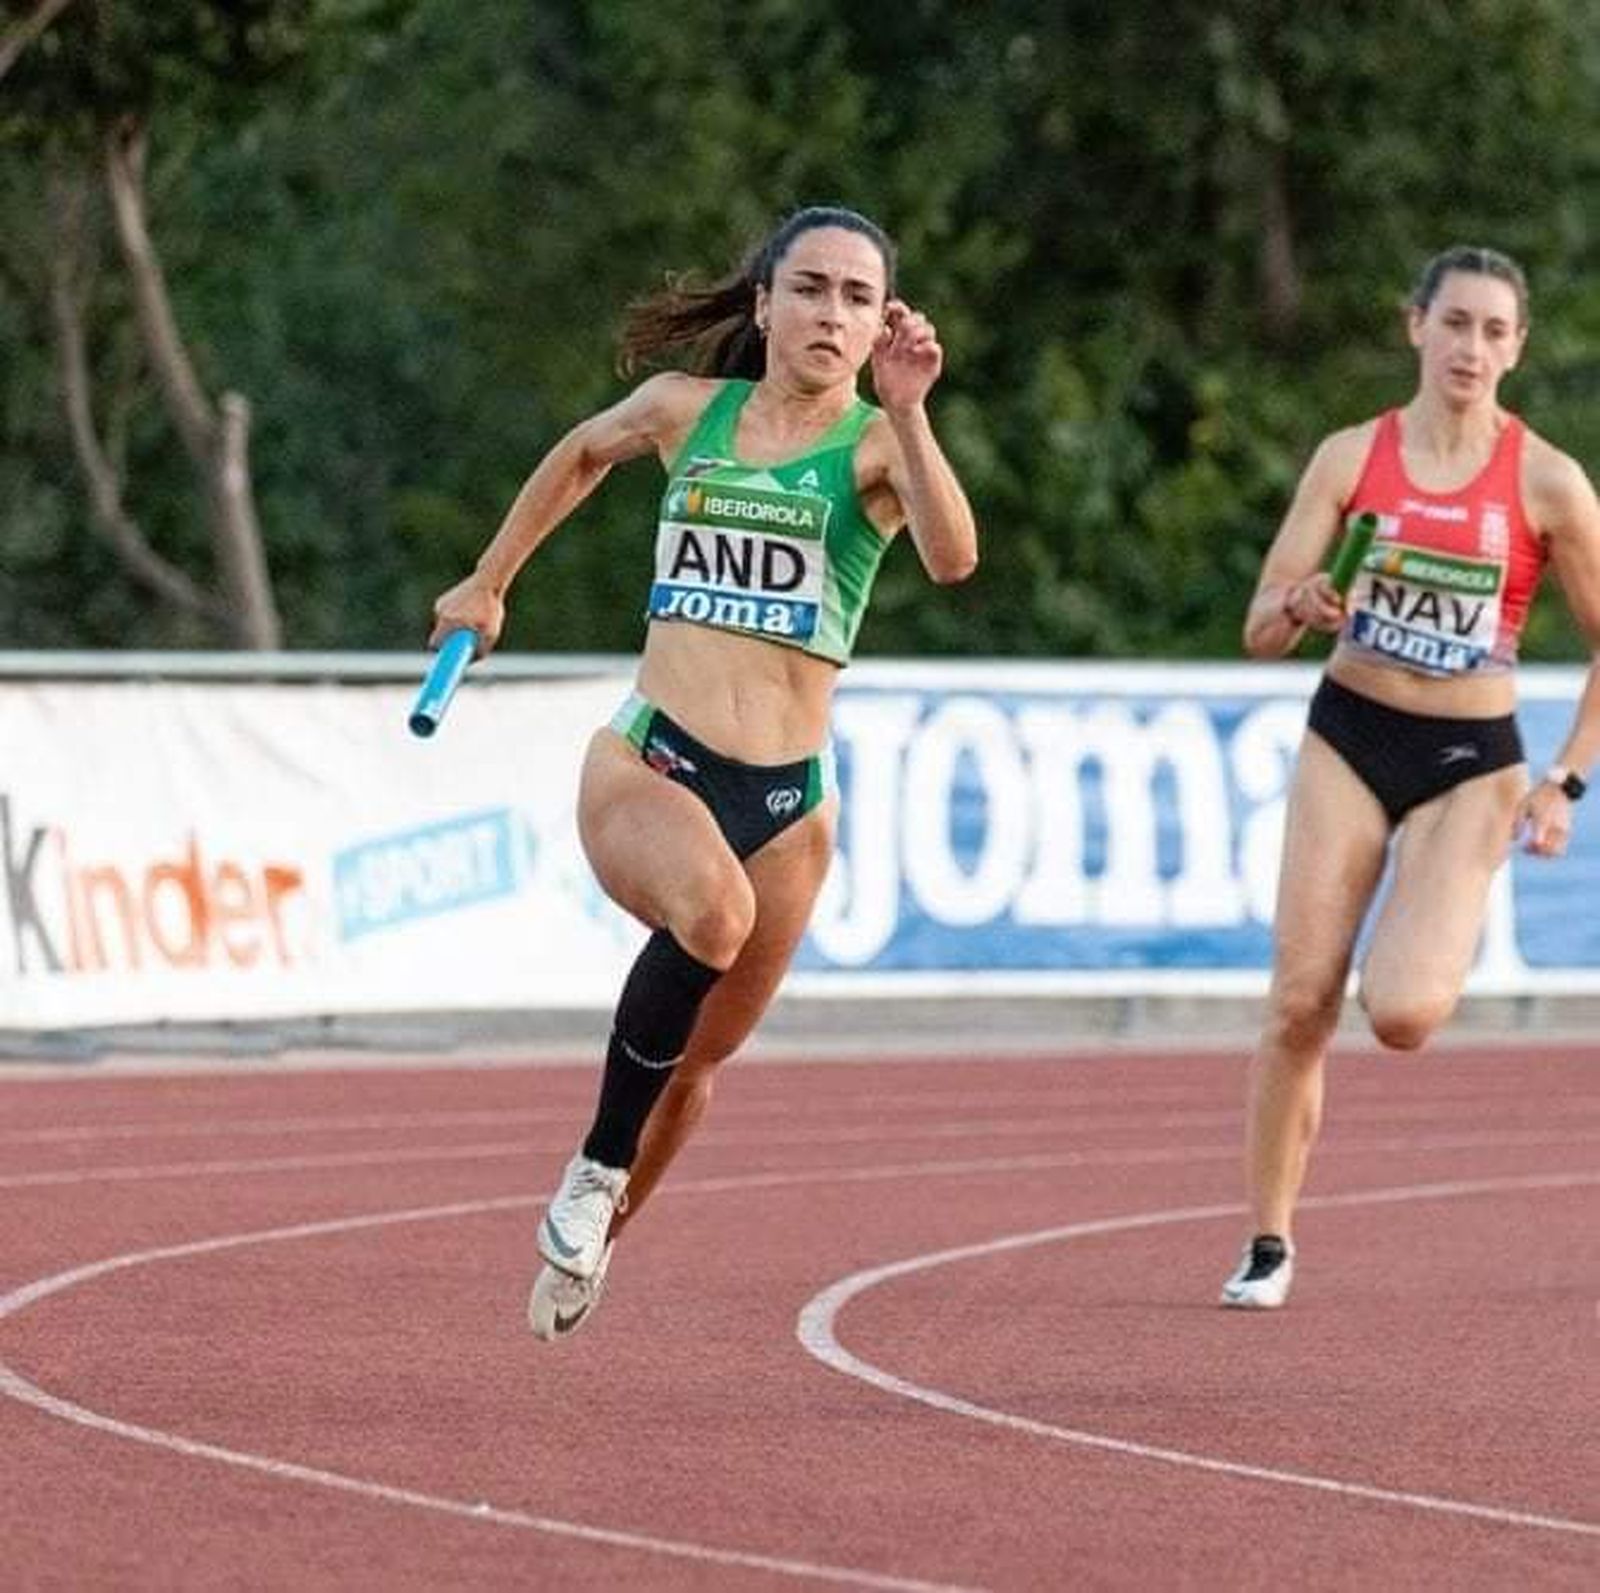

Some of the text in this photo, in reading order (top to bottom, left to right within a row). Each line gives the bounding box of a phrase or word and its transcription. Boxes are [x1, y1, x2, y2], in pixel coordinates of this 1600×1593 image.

[704, 496, 813, 526] IBERDROLA
[669, 530, 806, 592] AND
[1371, 579, 1483, 636] NAV
